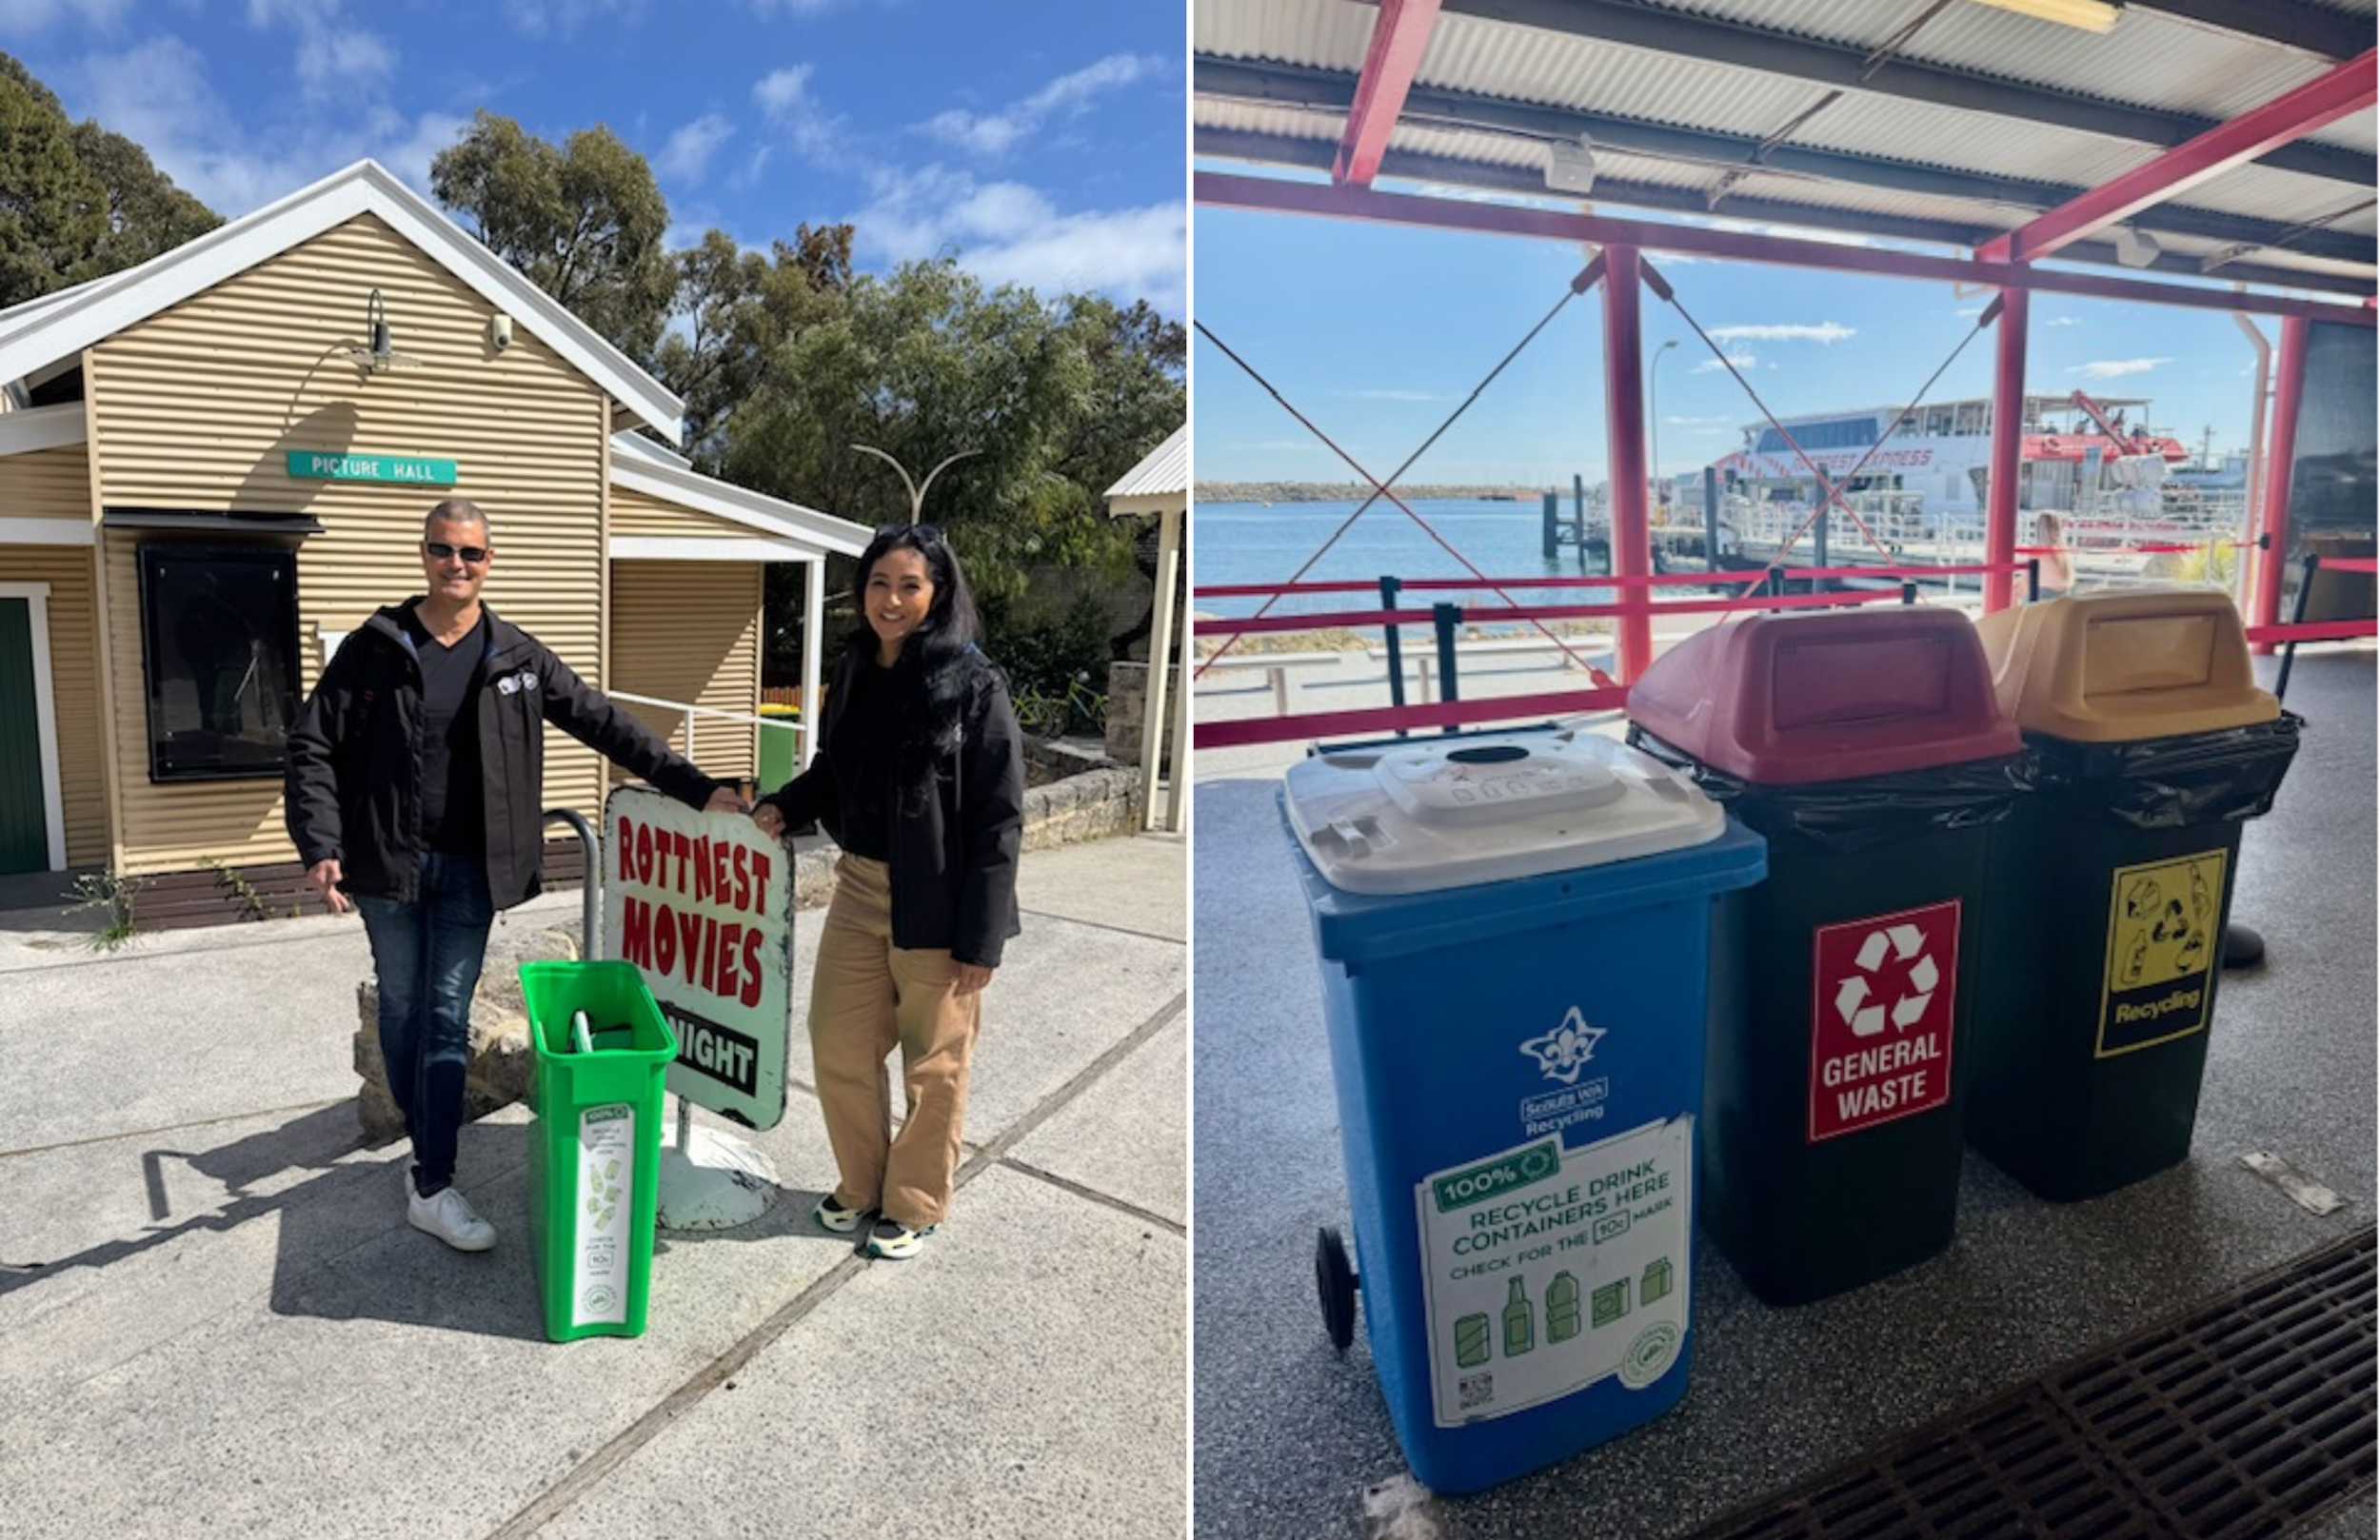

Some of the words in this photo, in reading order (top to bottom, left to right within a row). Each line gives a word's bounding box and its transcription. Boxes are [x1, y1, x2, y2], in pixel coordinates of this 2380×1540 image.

[311, 456, 380, 476] PICTURE
[393, 462, 436, 480] HALL
[619, 815, 770, 917] ROTTNEST
[622, 896, 764, 1008] MOVIES
[2115, 988, 2201, 1025] Recycling
[667, 1014, 755, 1085] NIGHT
[1823, 1032, 1942, 1088] GENERAL
[1525, 1104, 1604, 1137] Recycling
[1526, 1094, 1577, 1118] Scouts
[1837, 1069, 1928, 1121] WASTE
[1444, 1165, 1517, 1201] 100%
[1470, 1185, 1580, 1231] RECYCLE
[1589, 1157, 1656, 1198] DRINK
[1449, 1254, 1513, 1281] CHECK
[1517, 1243, 1553, 1265] FOR
[1557, 1231, 1590, 1252] THE
[1632, 1195, 1674, 1223] MARK
[1452, 1196, 1608, 1256] CONTAINERS
[1615, 1171, 1671, 1208] HERE
